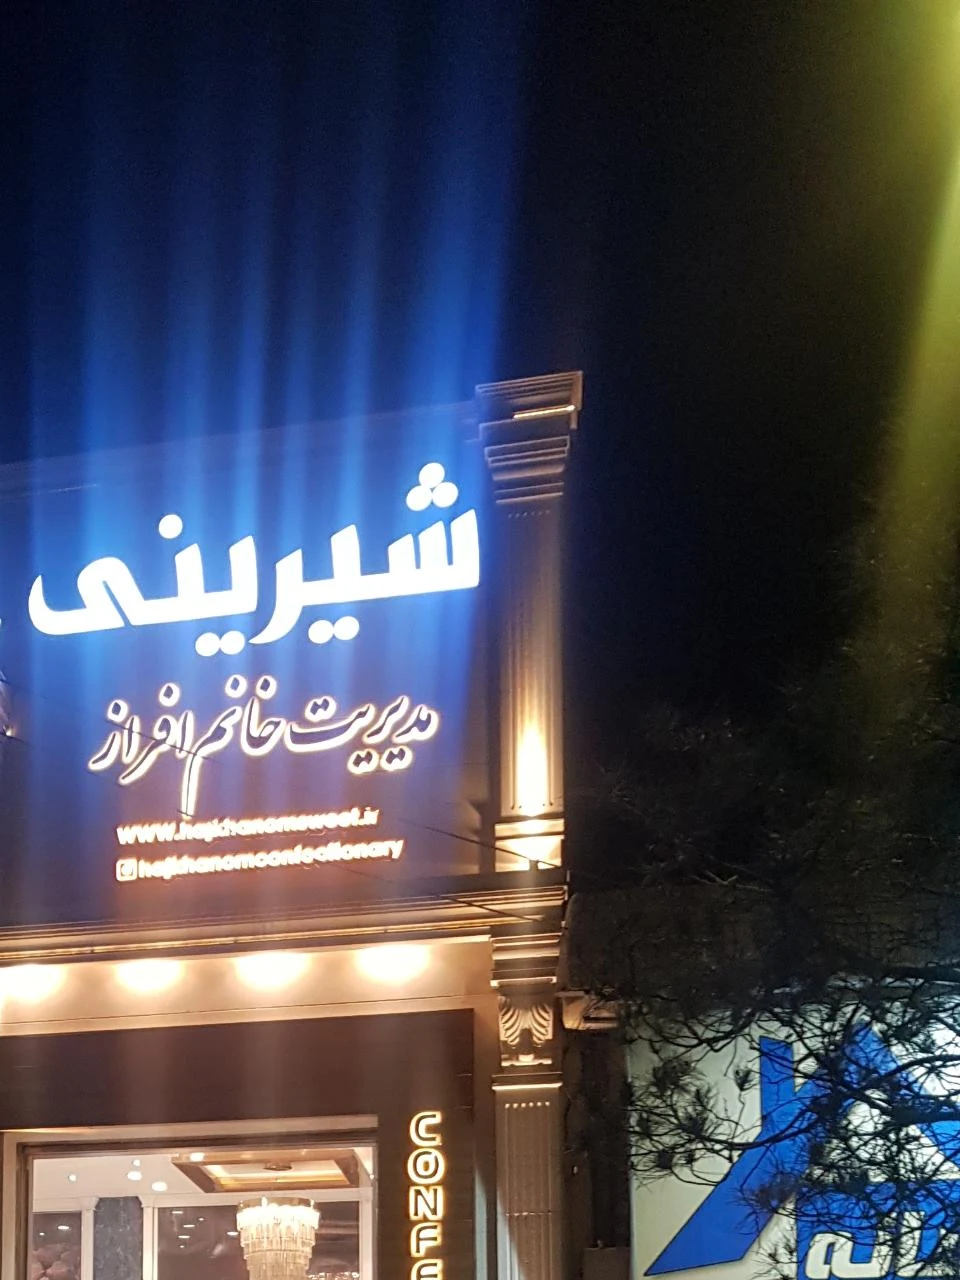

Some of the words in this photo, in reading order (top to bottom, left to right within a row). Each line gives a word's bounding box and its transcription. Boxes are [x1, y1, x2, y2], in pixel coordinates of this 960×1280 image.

[27, 461, 481, 657] شیرینی
[87, 682, 195, 786] افراز
[181, 674, 287, 821] خانم
[284, 695, 439, 775] مدیریت
